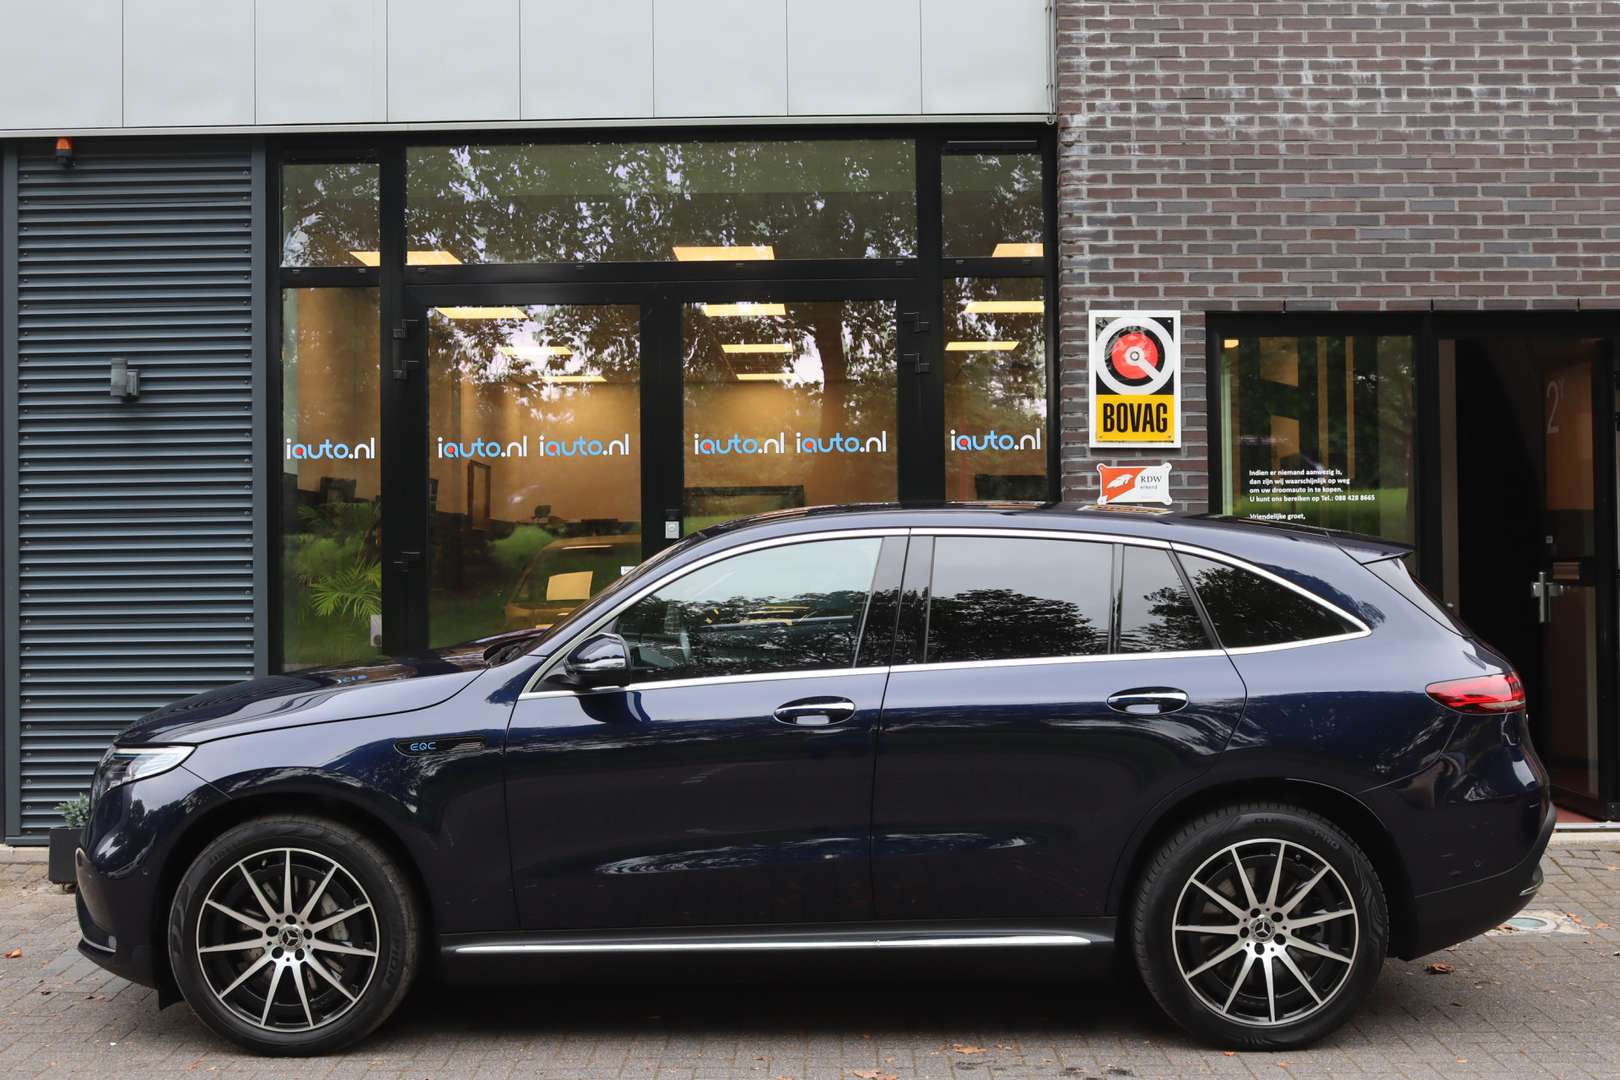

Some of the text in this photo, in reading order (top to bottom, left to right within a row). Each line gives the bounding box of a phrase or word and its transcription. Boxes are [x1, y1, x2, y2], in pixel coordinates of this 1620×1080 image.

[1103, 403, 1168, 433] BOVAG
[286, 437, 375, 460] iauto.nl
[437, 435, 528, 458] iauto.nl
[539, 433, 630, 457] iauto.nl
[694, 432, 785, 455] iauto.nl
[796, 430, 887, 453] iauto.nl
[950, 428, 1041, 451] iauto.nl
[1140, 475, 1162, 483] RDW
[410, 742, 437, 751] EQC
